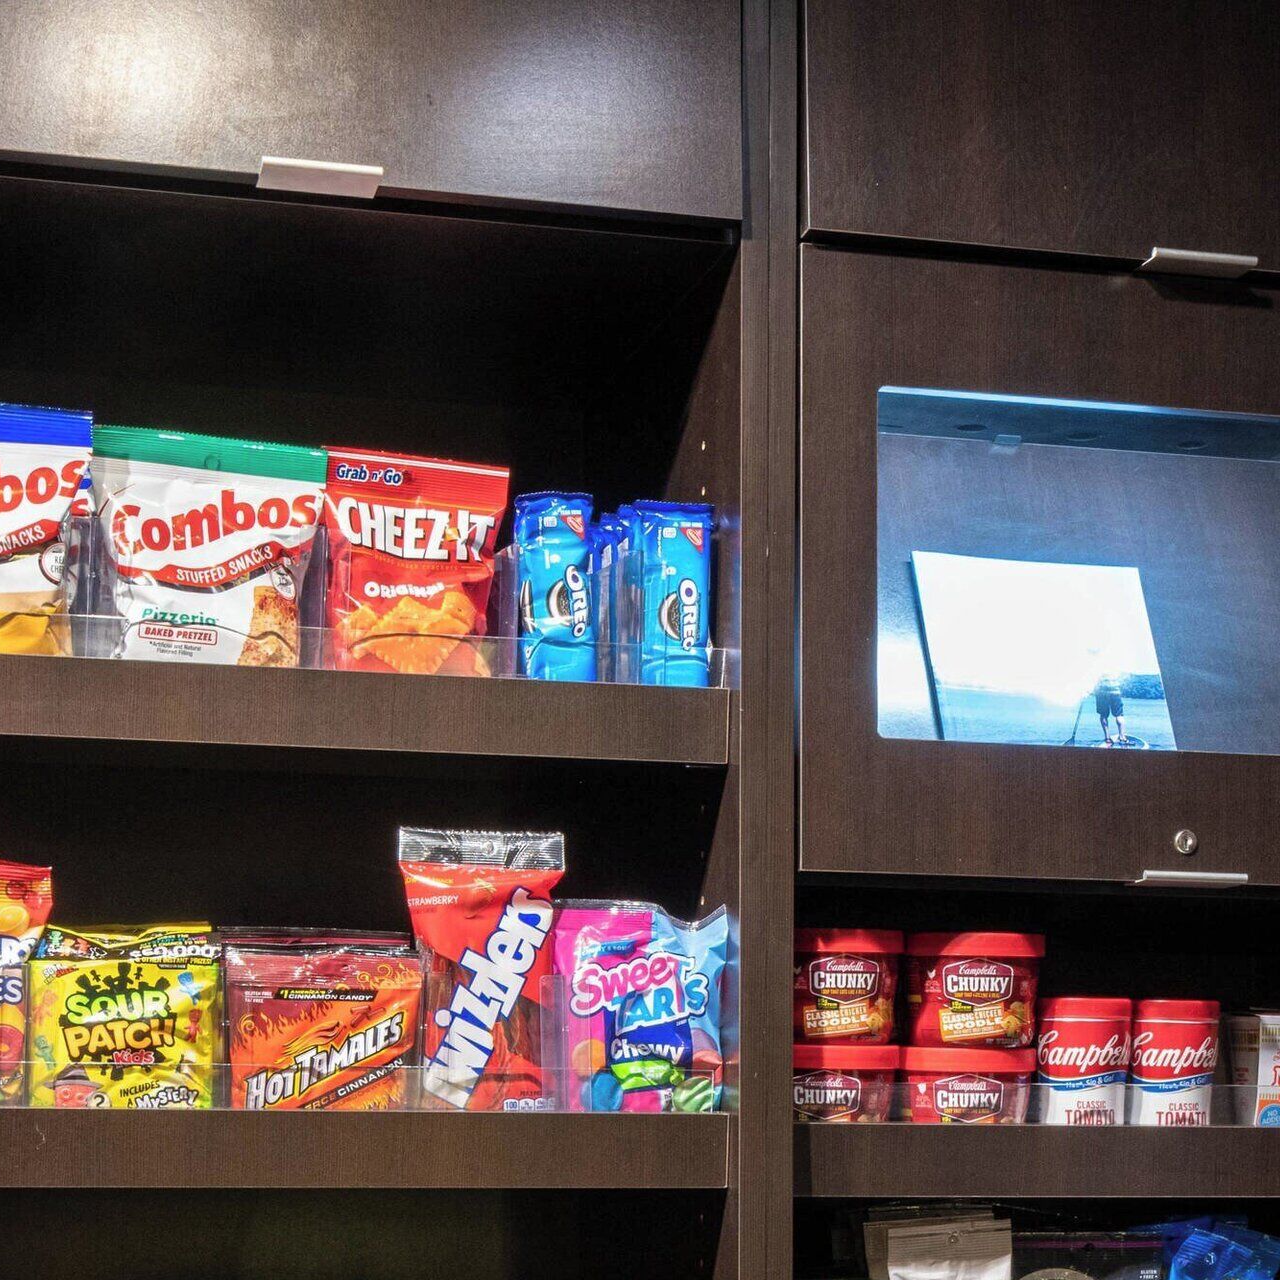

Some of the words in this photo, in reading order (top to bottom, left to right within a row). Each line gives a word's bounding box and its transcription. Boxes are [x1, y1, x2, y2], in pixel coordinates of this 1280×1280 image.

[336, 464, 367, 480] Grab
[384, 470, 402, 484] Go
[113, 489, 319, 554] Combos
[177, 562, 226, 584] STUFFED
[229, 546, 270, 572] SNACKS
[564, 565, 590, 638] OREO
[678, 578, 698, 651] OREO
[144, 627, 176, 638] BAKED
[178, 630, 213, 641] PRETZEL
[407, 896, 458, 906] STRAWBERRY
[814, 971, 875, 989] CHUNKY
[947, 975, 1008, 993] CHUNKY
[66, 991, 169, 1024] SOUR
[944, 1019, 1003, 1029] NOODLE
[64, 1019, 176, 1057] PATCH
[113, 1050, 154, 1064] Kids
[247, 1065, 299, 1108] HOT
[295, 1012, 403, 1096] TAMALES
[611, 1038, 684, 1064] Chewy
[120, 1081, 161, 1097] INCLUDES
[1077, 1101, 1106, 1109] CLASSIC
